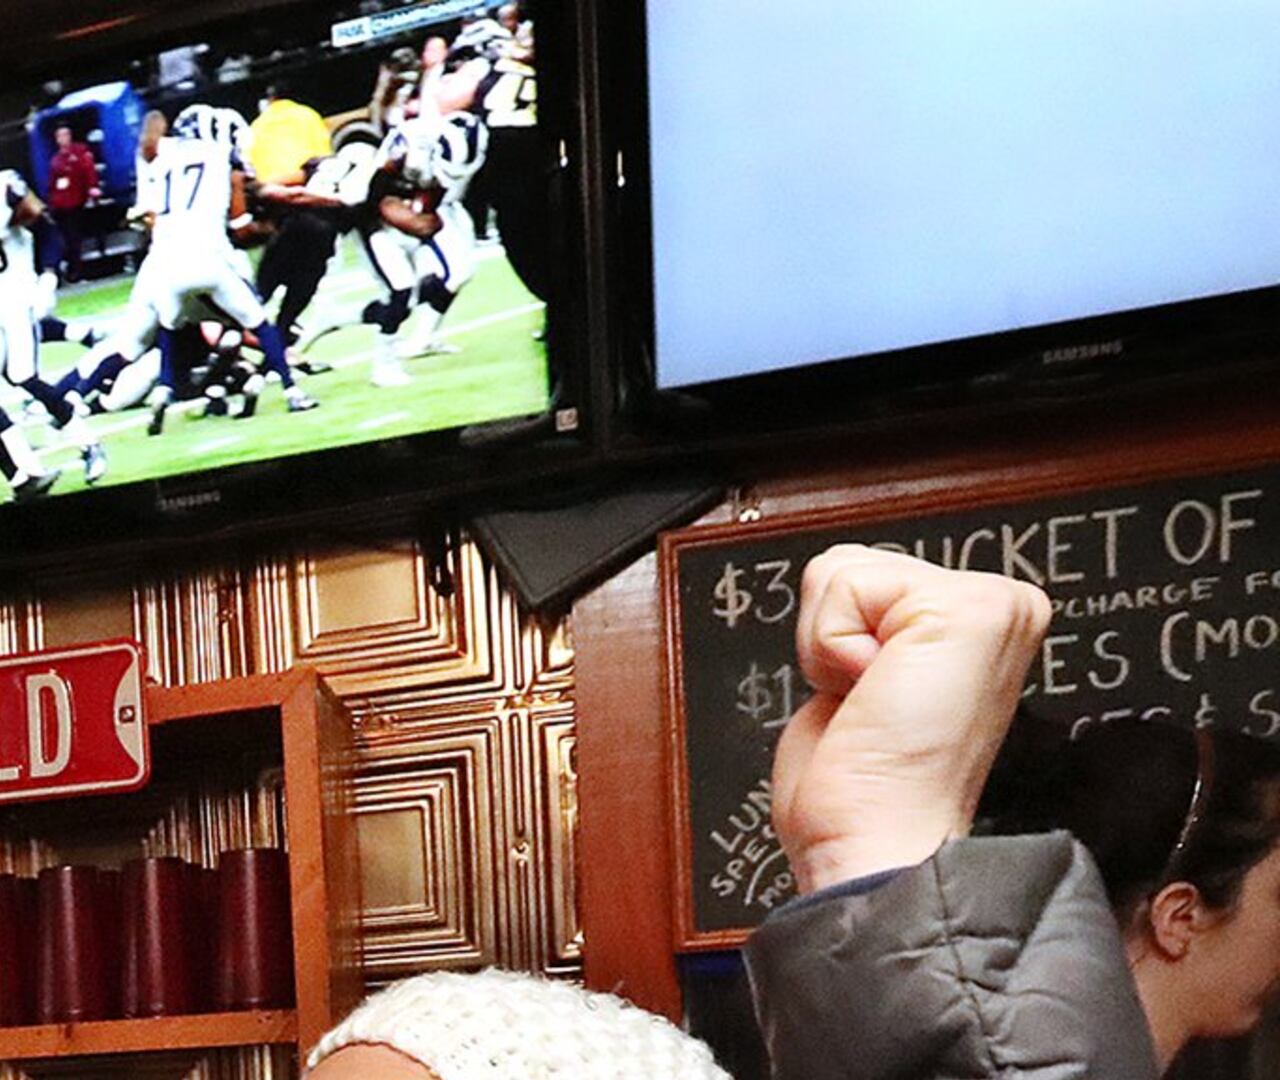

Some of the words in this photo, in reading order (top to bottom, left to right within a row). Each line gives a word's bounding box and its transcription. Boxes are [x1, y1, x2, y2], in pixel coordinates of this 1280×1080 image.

[160, 161, 206, 216] 17
[712, 560, 796, 628] $3
[868, 505, 1138, 586] CKET
[1162, 489, 1263, 566] OF
[1022, 630, 1130, 698] ES
